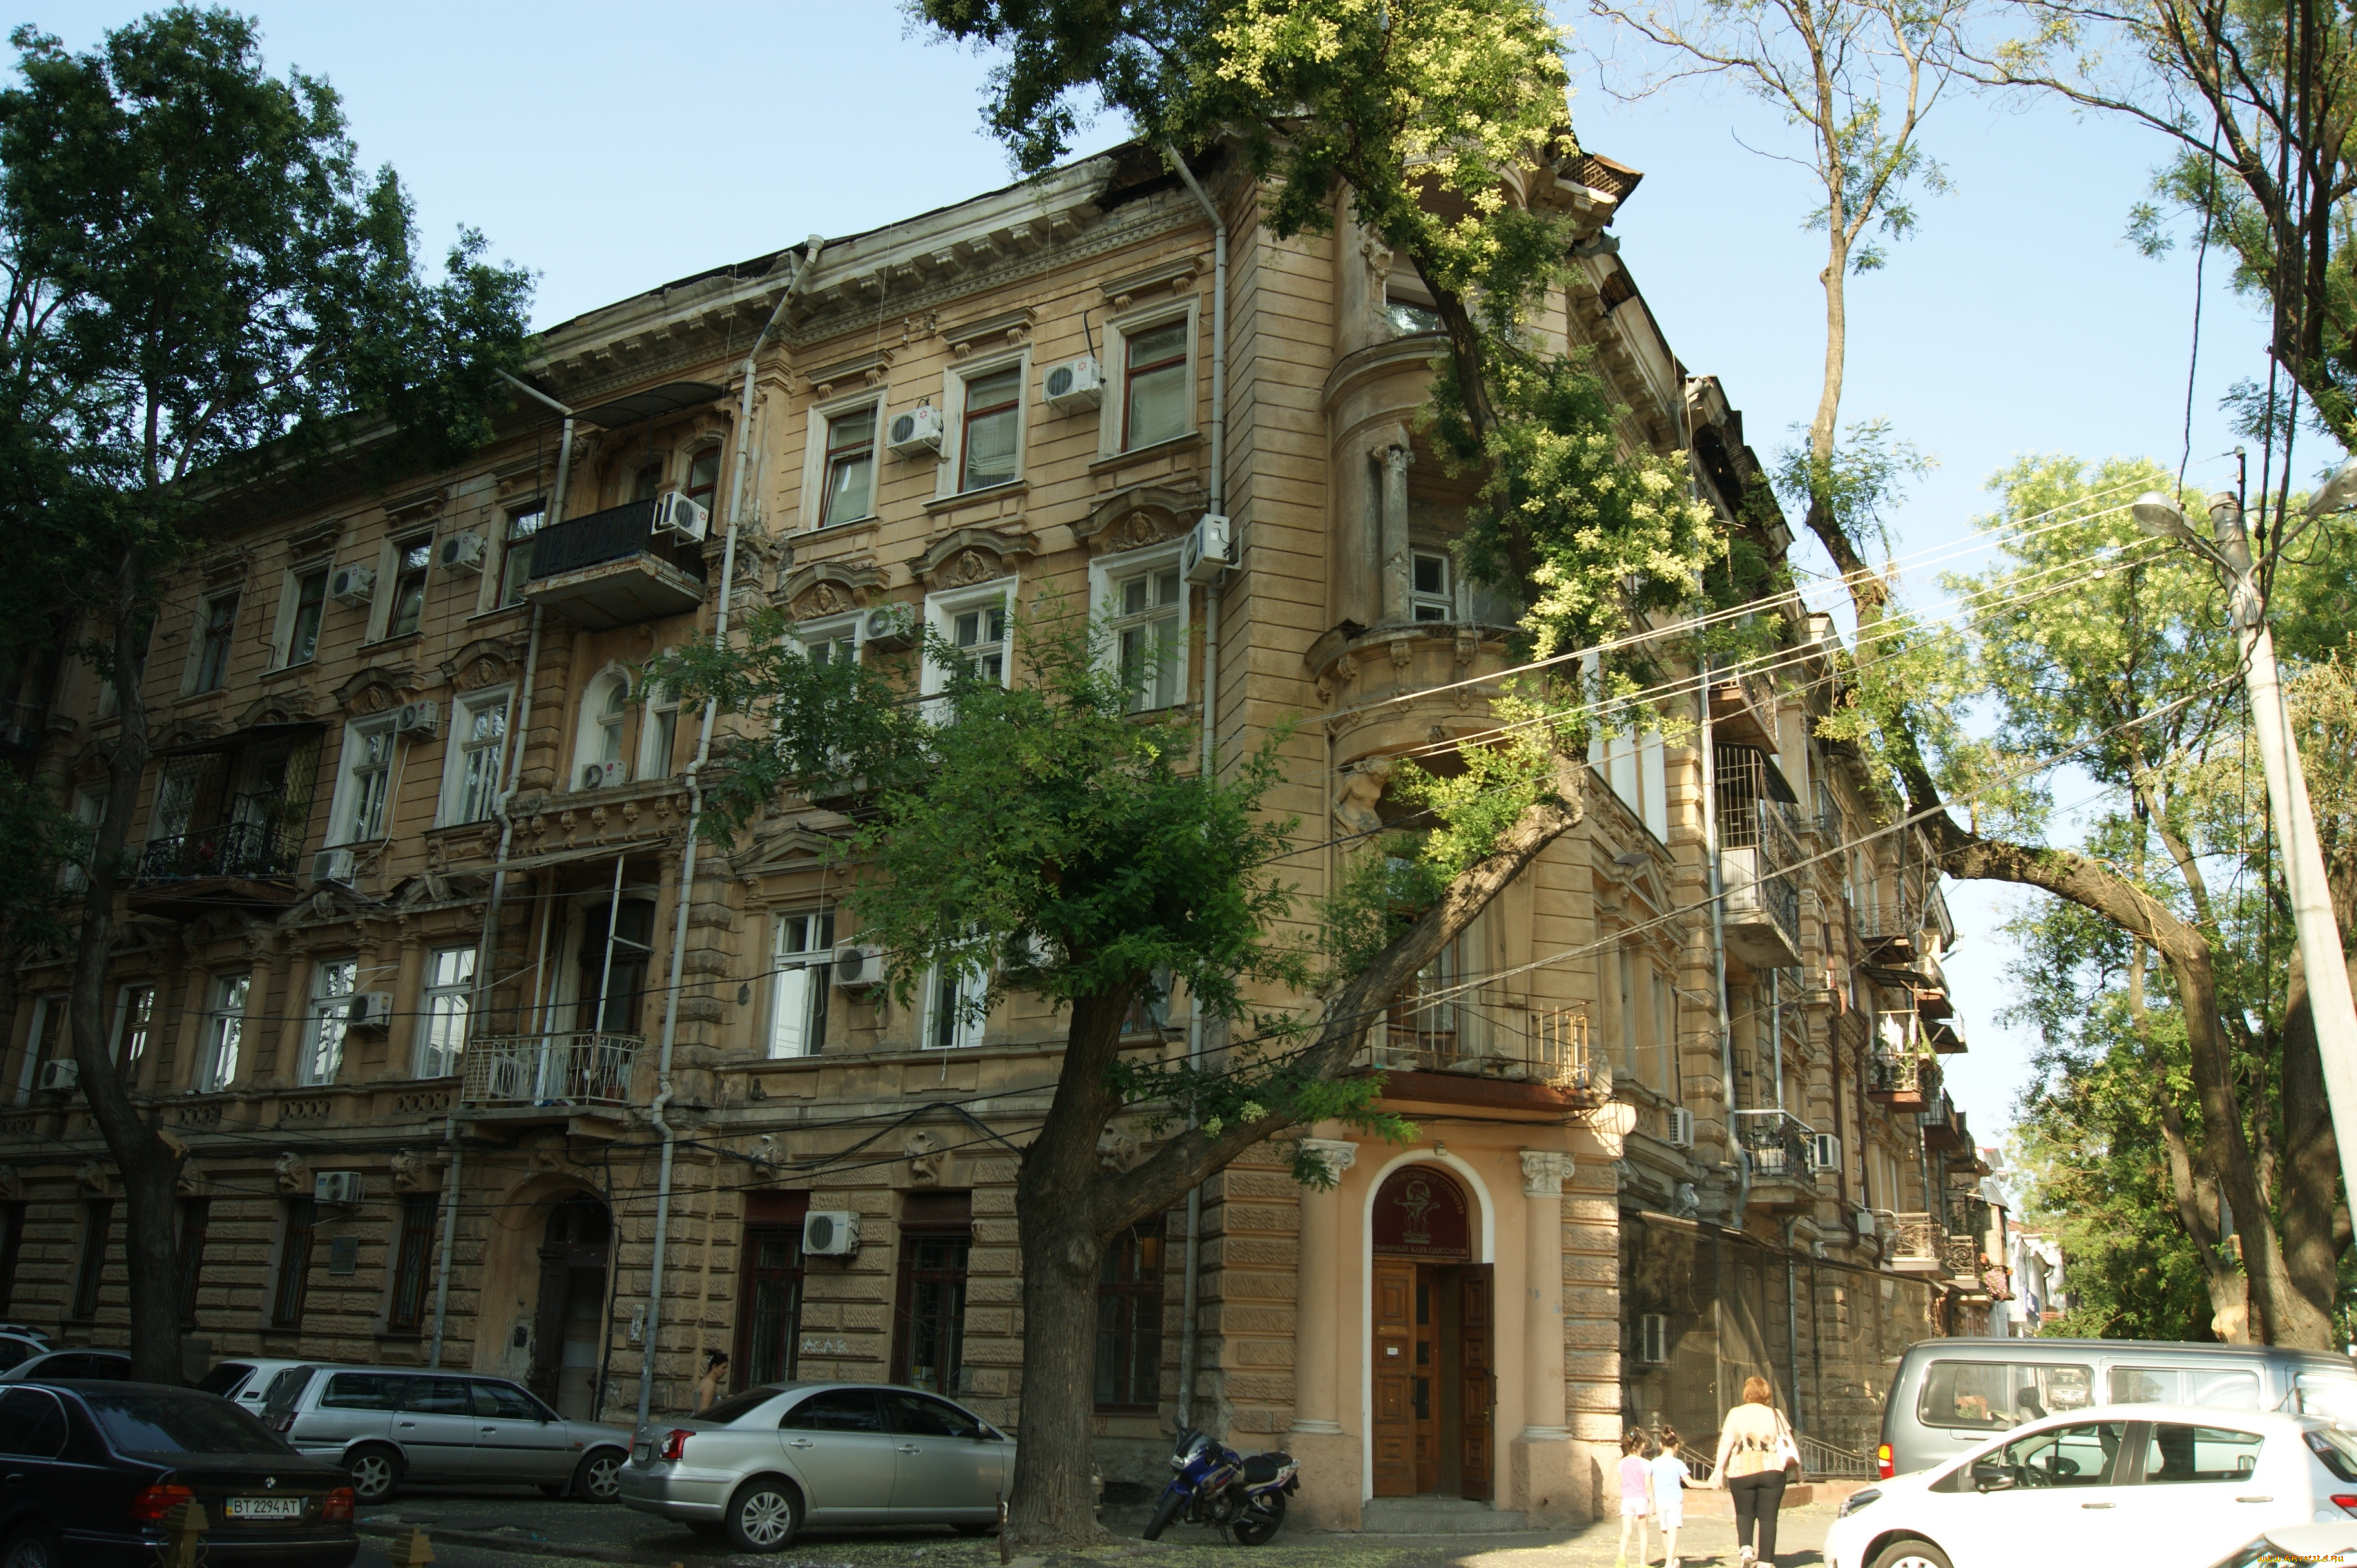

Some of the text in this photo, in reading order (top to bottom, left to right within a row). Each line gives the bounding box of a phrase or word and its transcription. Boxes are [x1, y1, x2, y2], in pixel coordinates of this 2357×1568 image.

[234, 1500, 297, 1513] BT 2294 AT
